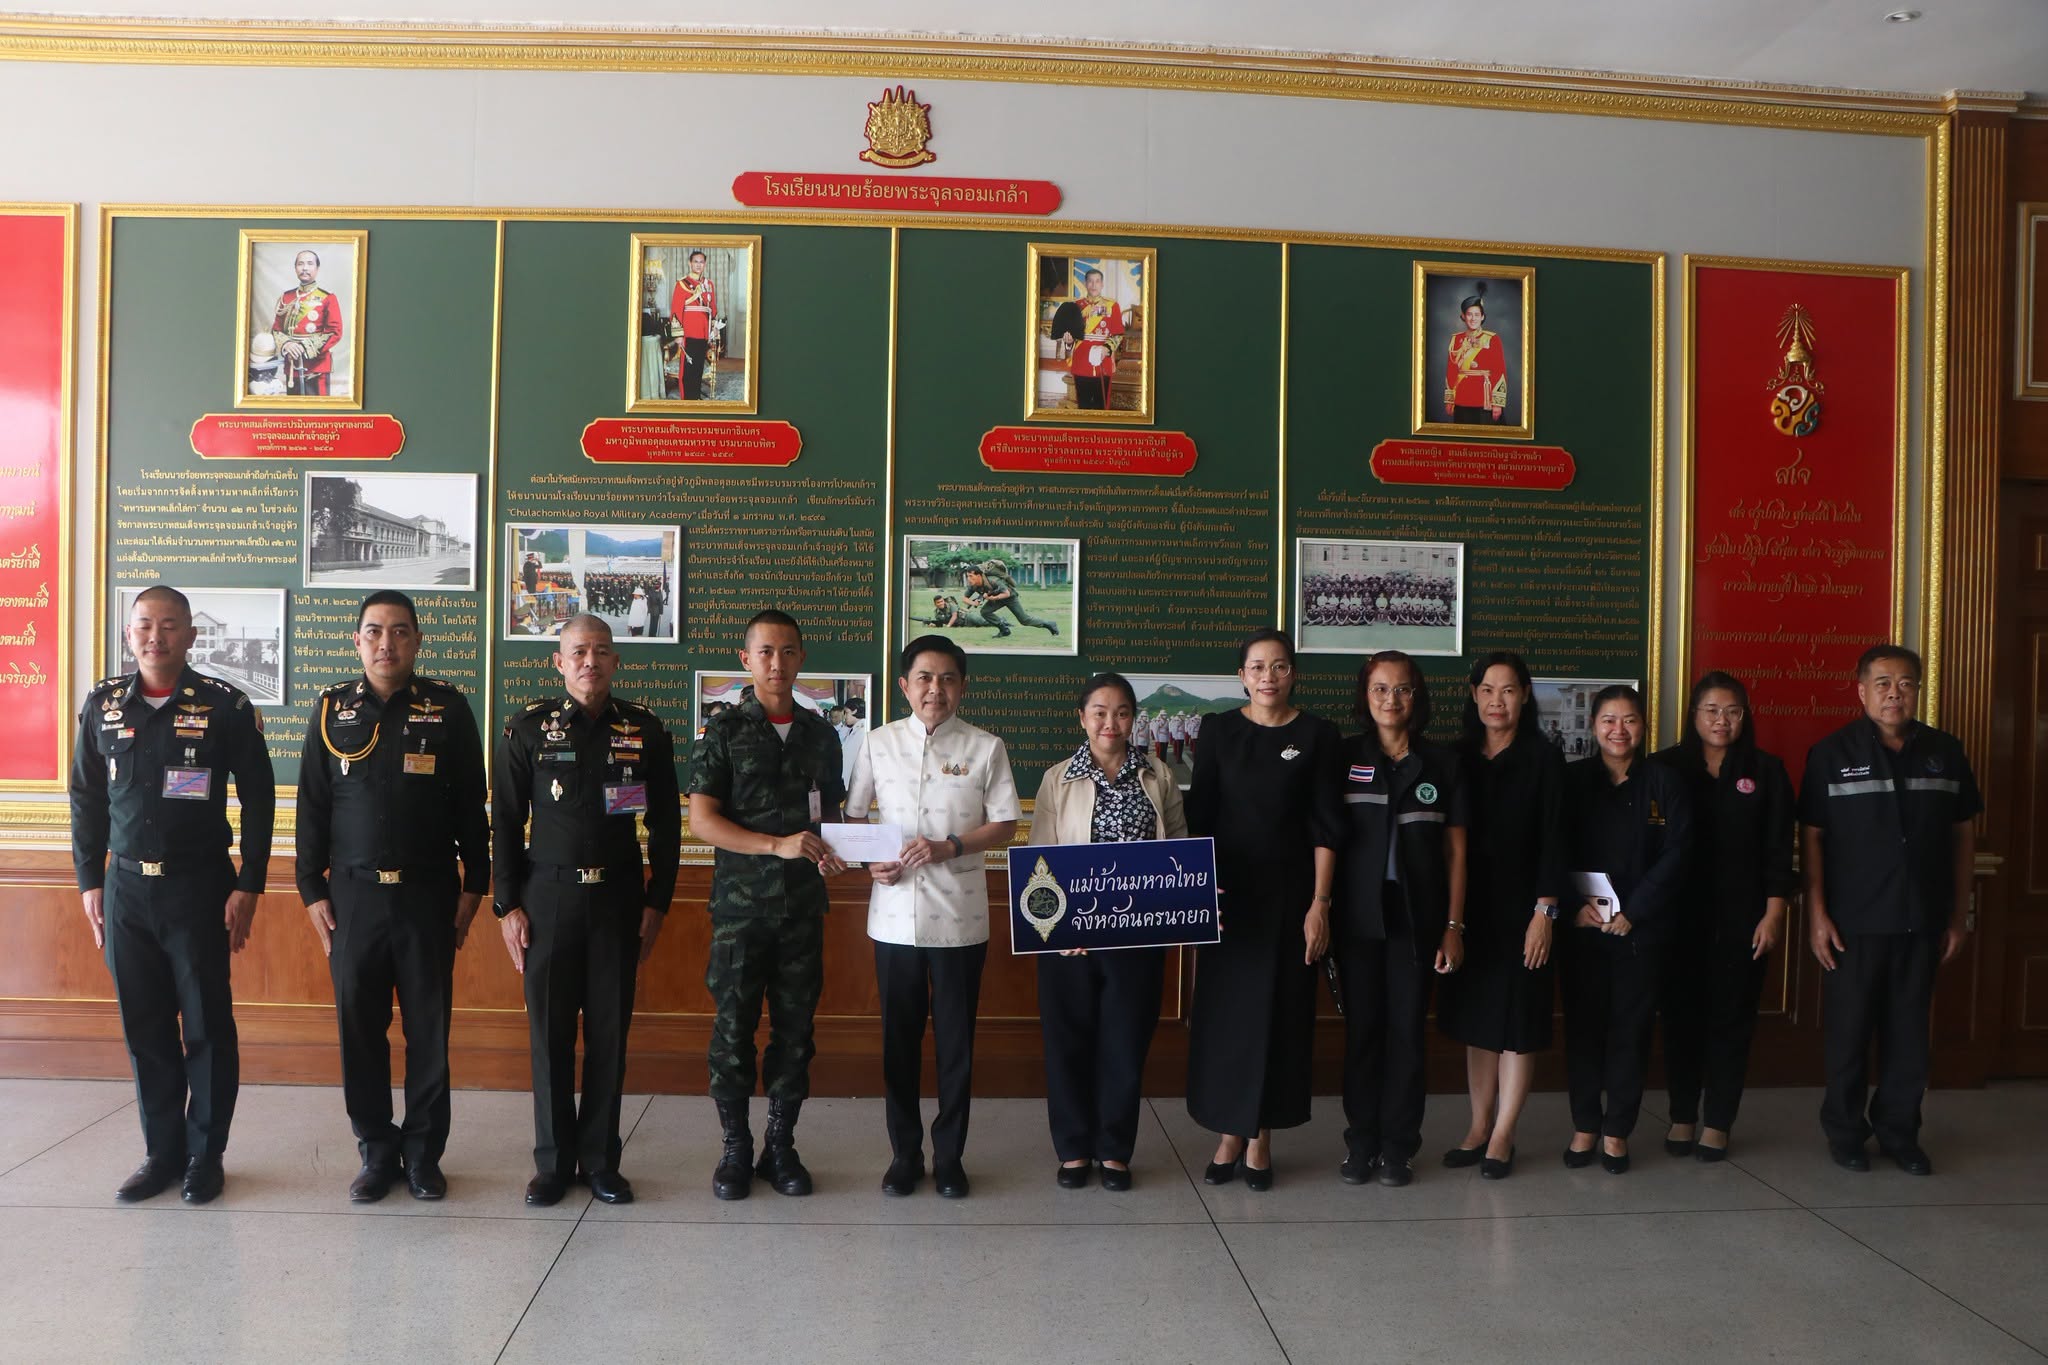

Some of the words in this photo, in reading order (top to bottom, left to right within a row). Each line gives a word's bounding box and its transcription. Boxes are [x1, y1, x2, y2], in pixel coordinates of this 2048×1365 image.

[764, 176, 1029, 207] โรงเรียนนายร้อยพระจุลจอมเกล้า
[621, 424, 760, 436] พระบาทสมเด็จพระบรมชนกาธิเบศร
[252, 431, 340, 445] พระจุลจอมเกล้าเจ้าอยู่หัว
[605, 436, 716, 449] มหาภูมิพลอดุลยเดชมหาราช
[720, 438, 776, 449] บรมนาถบพิตร
[647, 450, 682, 459] พุทธศักราช
[1095, 447, 1184, 462] พระวชิรเกล้าเจ้าอยู่หัว
[141, 467, 299, 482] โรงเรียนนายร้อยพระจุลจอมเกล้าถือกำเนิดขึ้น
[117, 485, 299, 497] โดยเริ่มจากการจัดตั้งทหารมหาดเล็กที่เรียกว่า
[807, 494, 876, 506] เขียนอักษรโรมันว่า
[202, 504, 228, 514] จำนวน
[261, 503, 298, 514] ในช่วงต้น
[584, 509, 609, 520] Royal
[611, 510, 646, 521] Military
[697, 509, 730, 520] เมื่อวันที่
[743, 512, 775, 521] มกราคม
[779, 513, 798, 521] พ.ศ.
[117, 519, 298, 533] รัชกาลพระบาทสมเด็จพระจุลจอมเกล้าเจ้าอยู่หัว
[850, 527, 875, 538] ในสมัย
[117, 535, 270, 547] และต่อมาได้เพิ่มจำนวนทหารมหาดเล็กเป็น
[286, 539, 297, 547] คน
[688, 541, 848, 554] พระบาทสมเด็จพระจุลจอมเกล้าเจ้าอยู่หัว
[853, 543, 874, 553] ให้ใช้
[117, 551, 298, 564] แต่งตั้งเป็นกองทหารมหาดเล็กสำหรับรักษาพระองค์
[688, 555, 771, 566] เป็นตราประจำโรงเรียน
[774, 556, 874, 568] และยังให้ใช้เป็นเครื่องหมาย
[116, 568, 160, 580] อย่างใกล้ชิด
[688, 569, 744, 580] เหล่าและสังกัด
[748, 571, 852, 582] ของนักเรียนนายร้อยอีกด้วย
[856, 572, 873, 583] ในปี
[688, 586, 707, 595] พ.ศ.
[833, 585, 873, 598] ให้ย้ายที่ตั้ง
[293, 594, 311, 605] ในปี
[412, 595, 477, 608] ให้จัดตั้งโรงเรียน
[688, 599, 772, 612] มาอยู่ที่บริเวณเขาชะโงก
[775, 601, 837, 612] จังหวัดนครนายก
[840, 601, 873, 613] เนื่องจาก
[295, 612, 360, 623] สอนวิชาทหารสำ
[416, 611, 438, 624] ไปขึ้น
[442, 614, 477, 625] โดยให้ใช้
[294, 626, 354, 639] พื้นที่บริเวณด้าน
[688, 627, 716, 639] เพิ่มขึ้น
[722, 632, 745, 641] ทรงก
[801, 631, 832, 642] ลาฤกษ์
[838, 630, 873, 642] เมื่อวันที่
[293, 645, 324, 657] ใช้ชื่อว่า
[326, 646, 361, 660] คะเด็ตสกู
[415, 648, 438, 659] ธีเปิด
[442, 647, 477, 660] เมื่อวันที่
[698, 644, 732, 655] สิงหาคม
[303, 663, 333, 673] สิงหาคม
[439, 668, 476, 677] พฤษภาคม
[503, 656, 550, 668] และเมื่อวันที่
[651, 660, 689, 671] ข้าราชการ
[503, 676, 531, 688] ลูกจ้าง
[538, 677, 566, 687] นักเรีย
[611, 679, 688, 689] พร้อมด้วยศิษย์เก่า
[294, 697, 318, 708] นายร้
[262, 713, 310, 725] หารบกคับแ
[1068, 856, 1209, 894] แม่บ้านมหาดไทย
[1071, 894, 1211, 931] จังหวัดนครนายก
